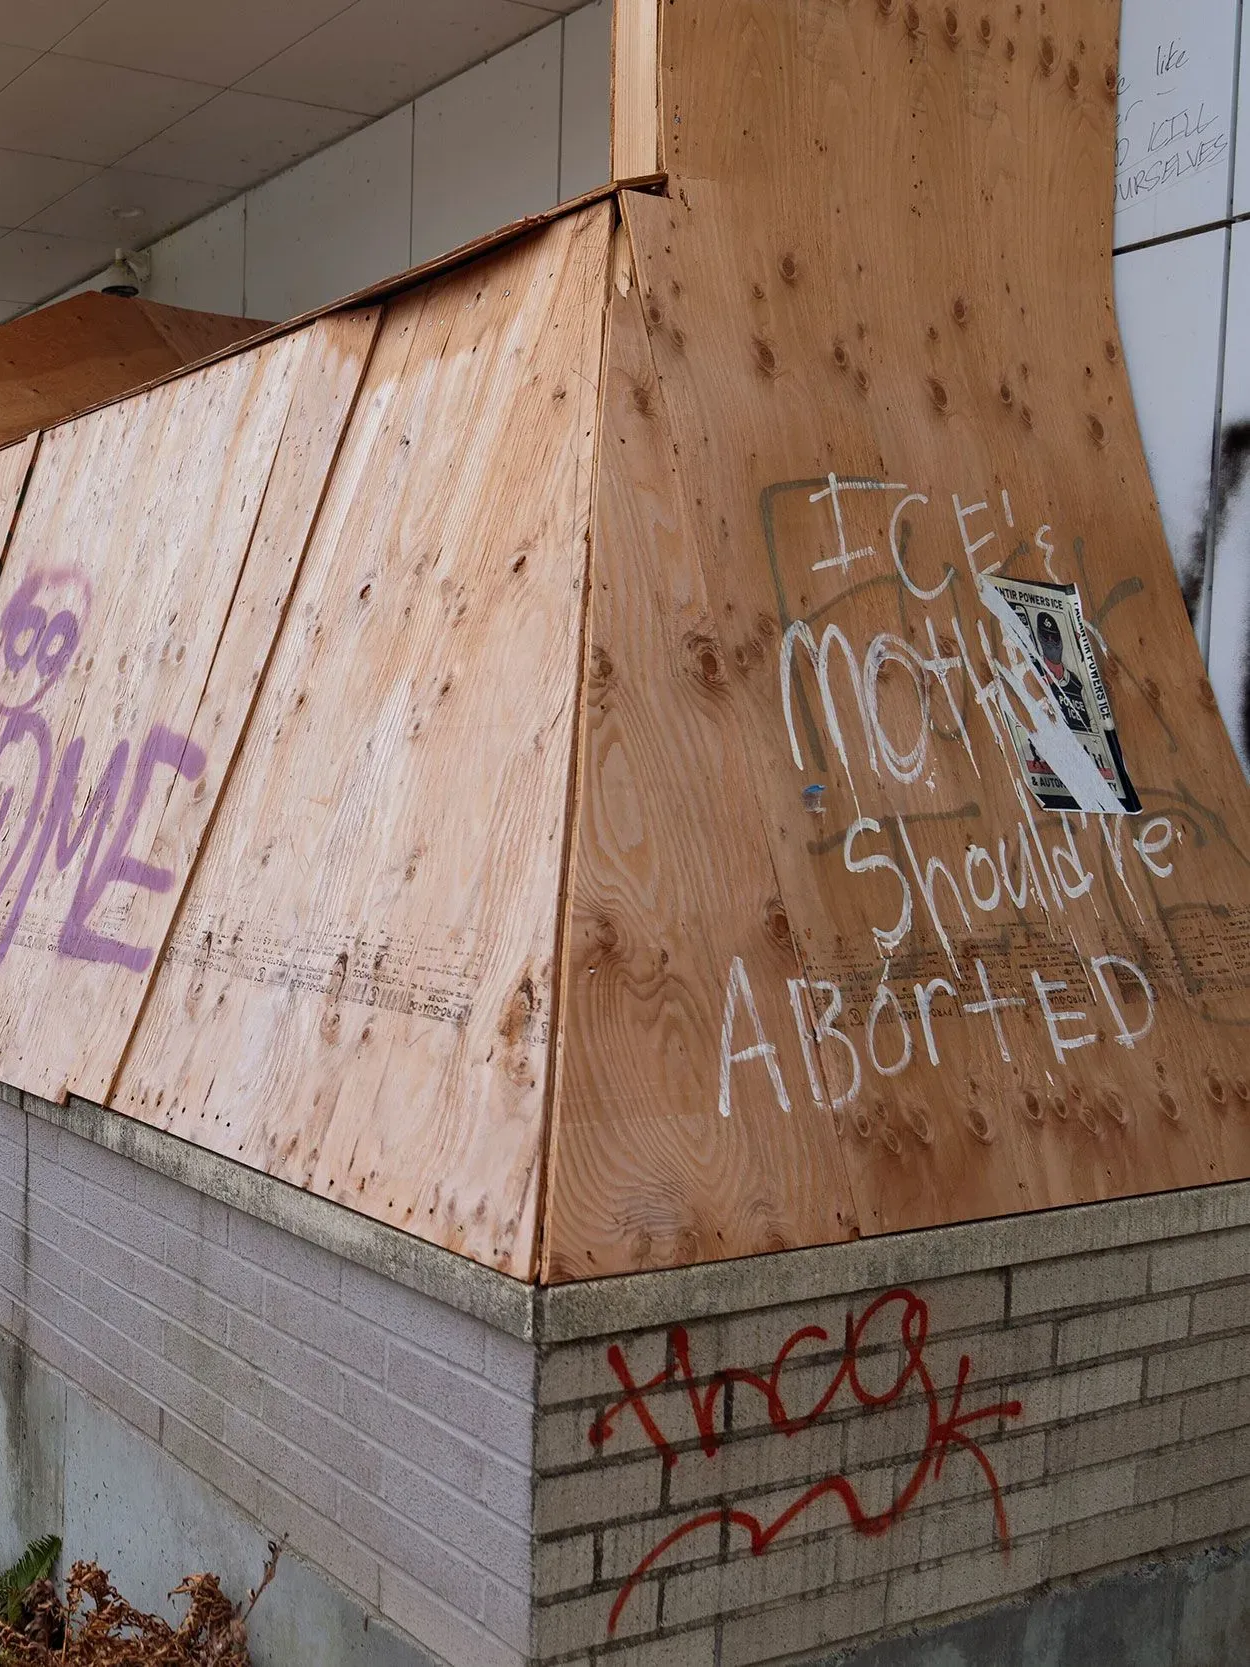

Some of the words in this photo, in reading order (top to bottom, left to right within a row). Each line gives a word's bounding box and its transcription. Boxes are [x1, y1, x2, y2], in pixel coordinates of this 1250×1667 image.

[1156, 40, 1190, 76] like
[1147, 102, 1220, 153] KILL
[1018, 591, 1051, 608] POWERS
[1051, 597, 1064, 611] ICE
[1086, 655, 1106, 702] POWERS
[1098, 701, 1111, 721] ICE
[1031, 776, 1038, 787] &
